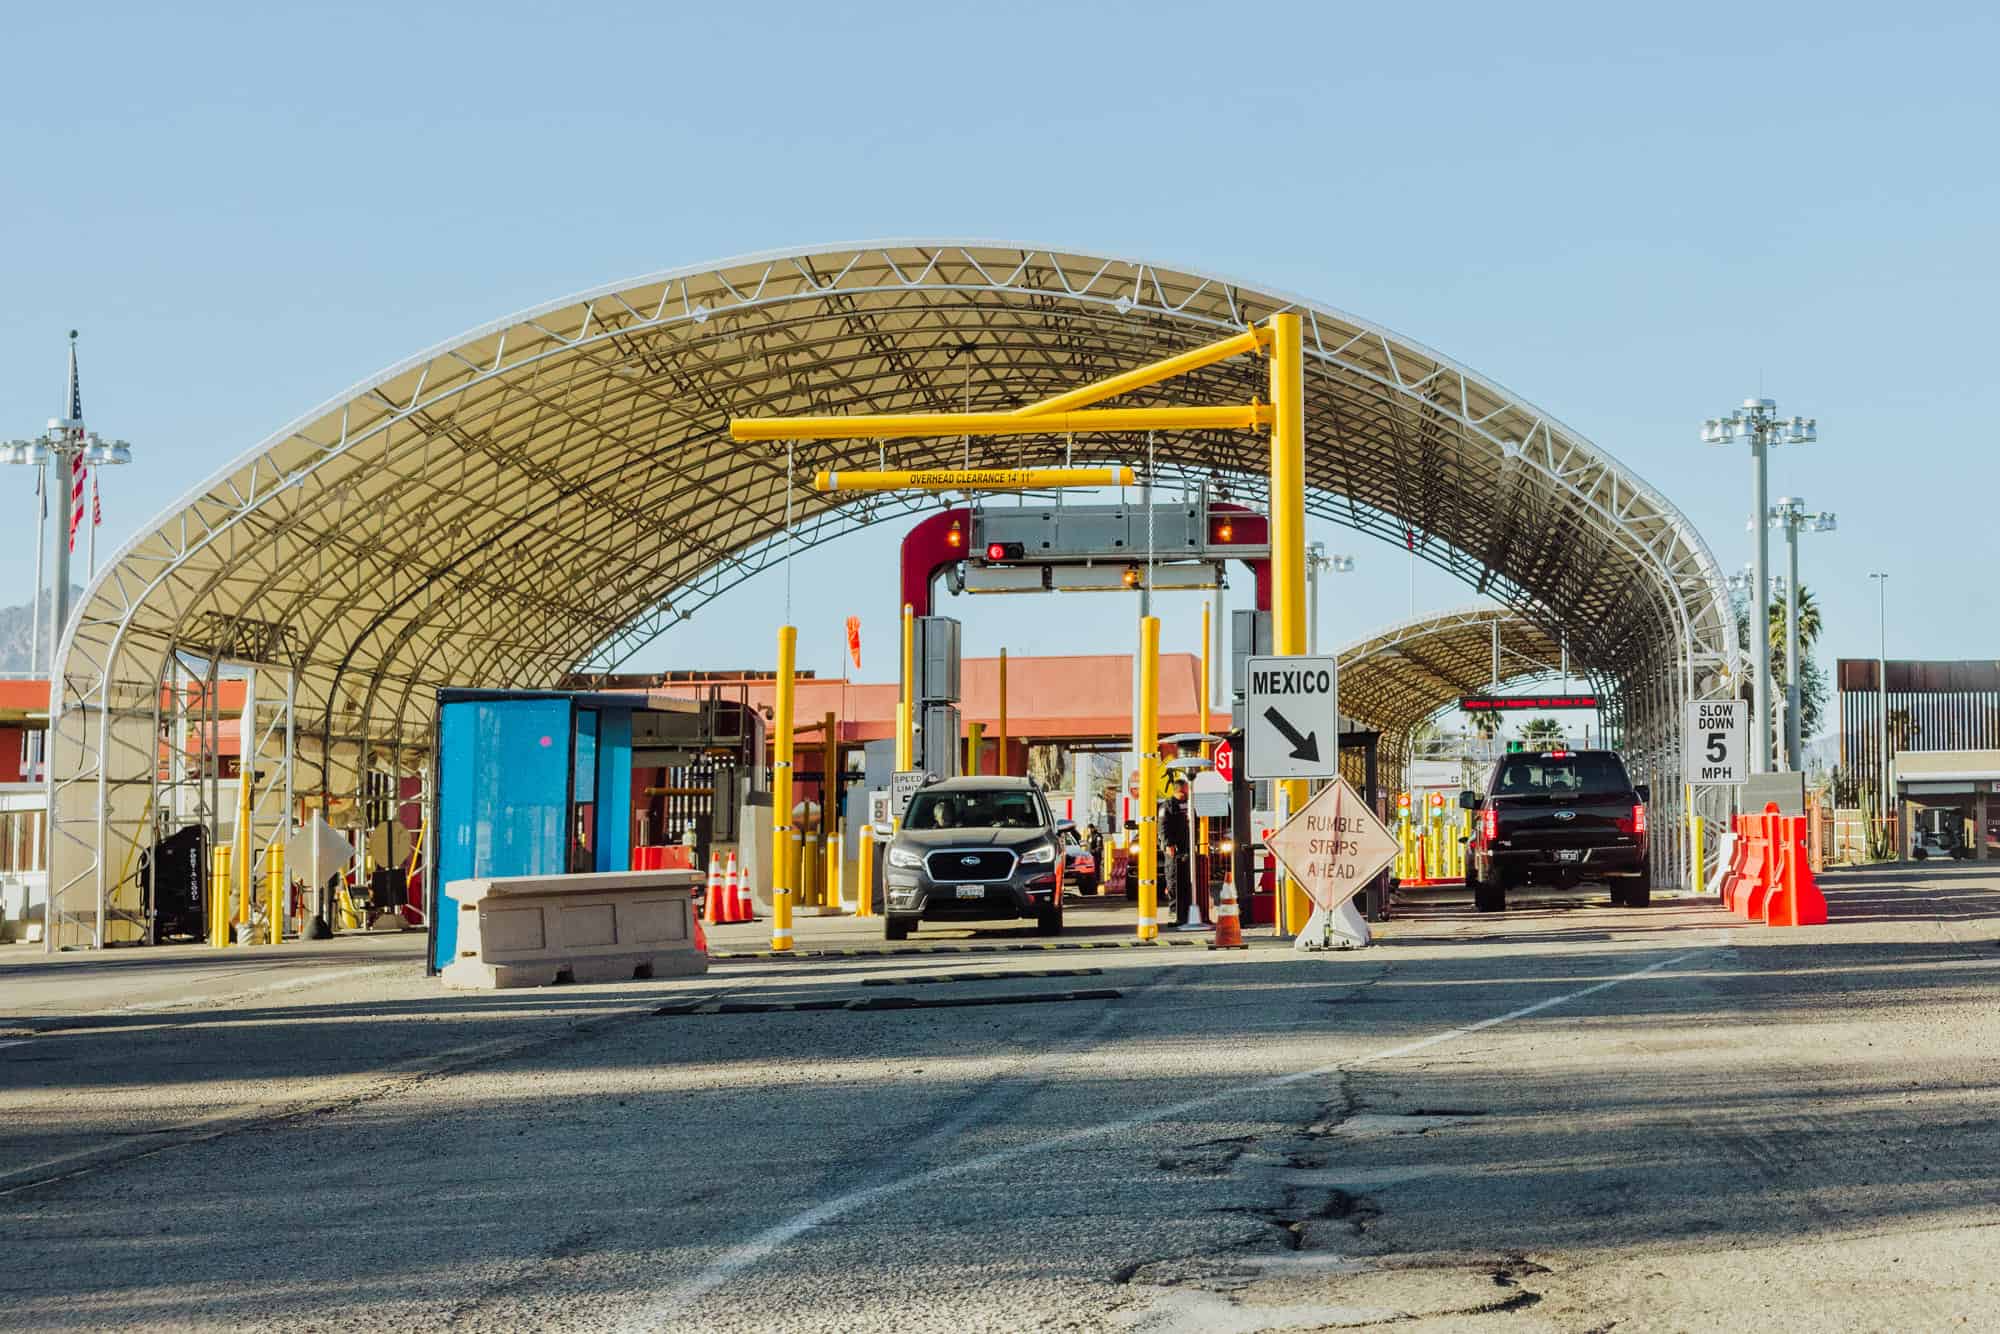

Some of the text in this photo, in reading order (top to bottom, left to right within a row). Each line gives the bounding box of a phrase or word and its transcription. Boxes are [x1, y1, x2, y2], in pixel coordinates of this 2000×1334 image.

[911, 473, 953, 484] OVERHEAD
[956, 473, 1006, 484] CLEARANCE
[1253, 670, 1330, 695] MEXICO
[1699, 704, 1733, 717] SLOW
[1699, 717, 1734, 729] DOWN
[1706, 732, 1727, 763] 5
[894, 775, 922, 783] SPEED
[1702, 767, 1732, 779] MPH
[1307, 815, 1365, 833] RUMBLE
[1309, 839, 1358, 856] STRIPS
[1308, 863, 1355, 879] AHEAD
